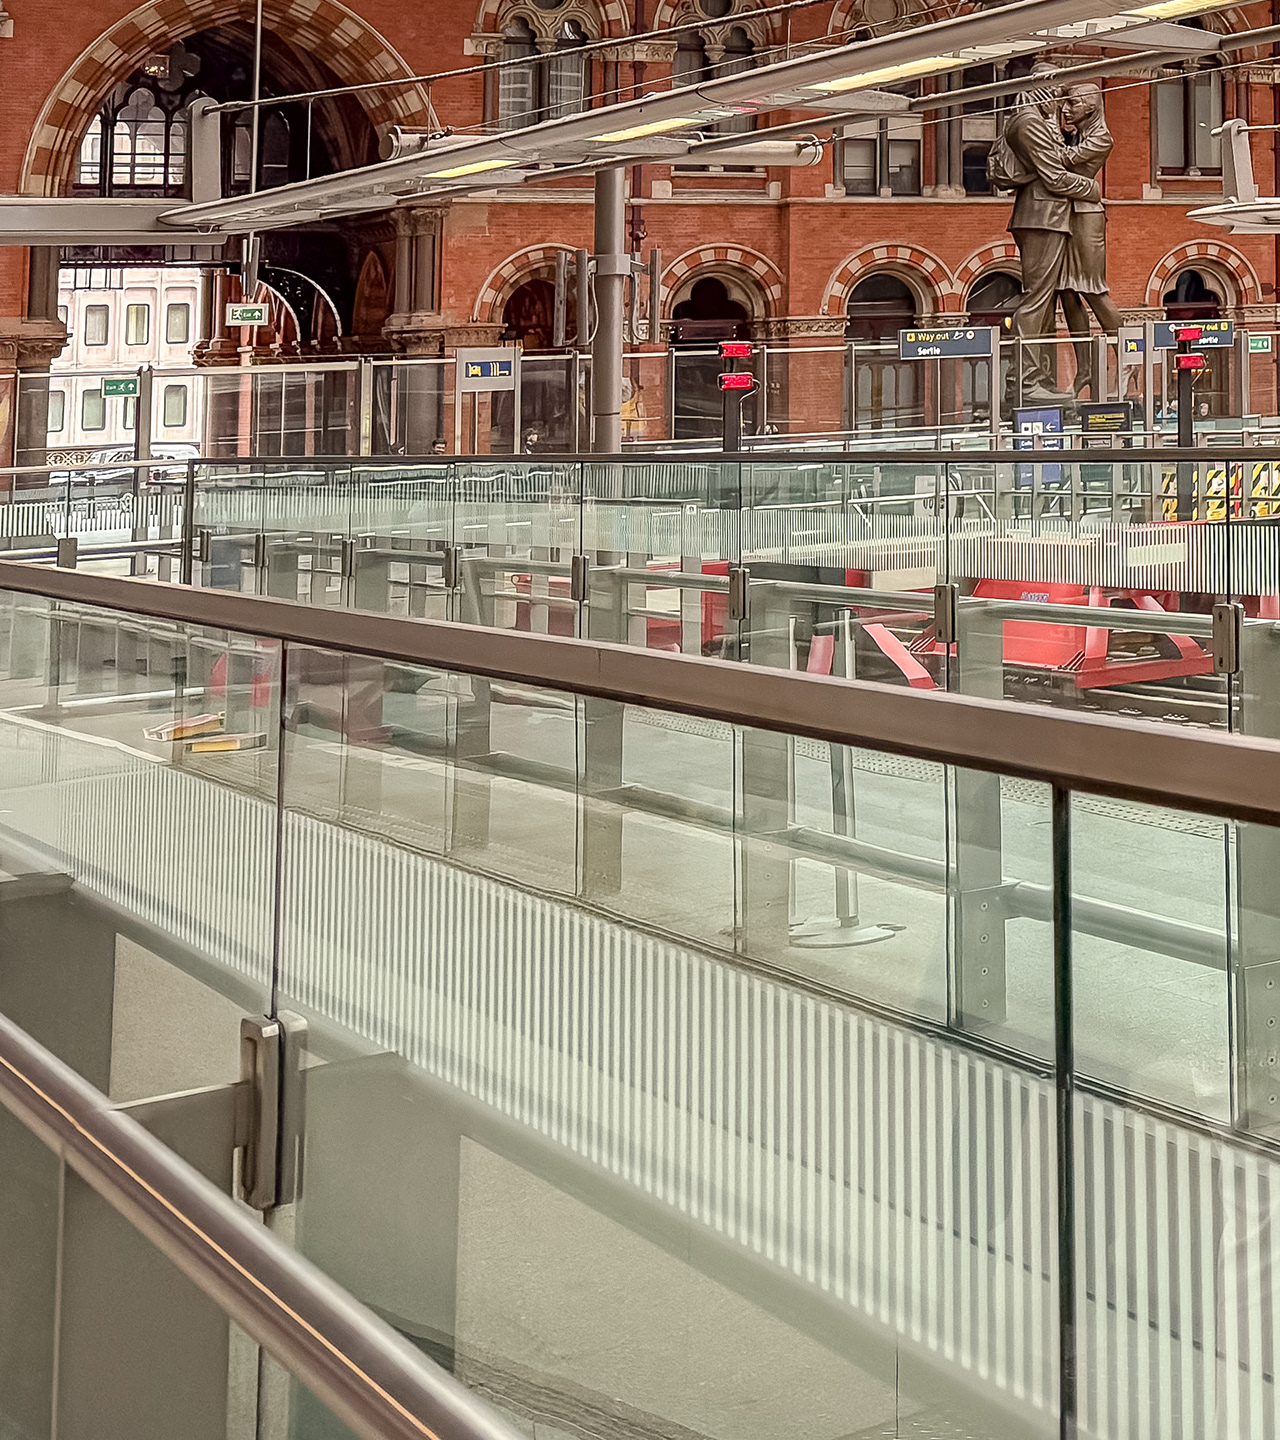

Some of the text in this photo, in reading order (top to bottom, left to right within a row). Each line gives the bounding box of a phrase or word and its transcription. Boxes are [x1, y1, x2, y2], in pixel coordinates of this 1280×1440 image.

[917, 332, 950, 343] Way out
[917, 346, 941, 356] Sortie
